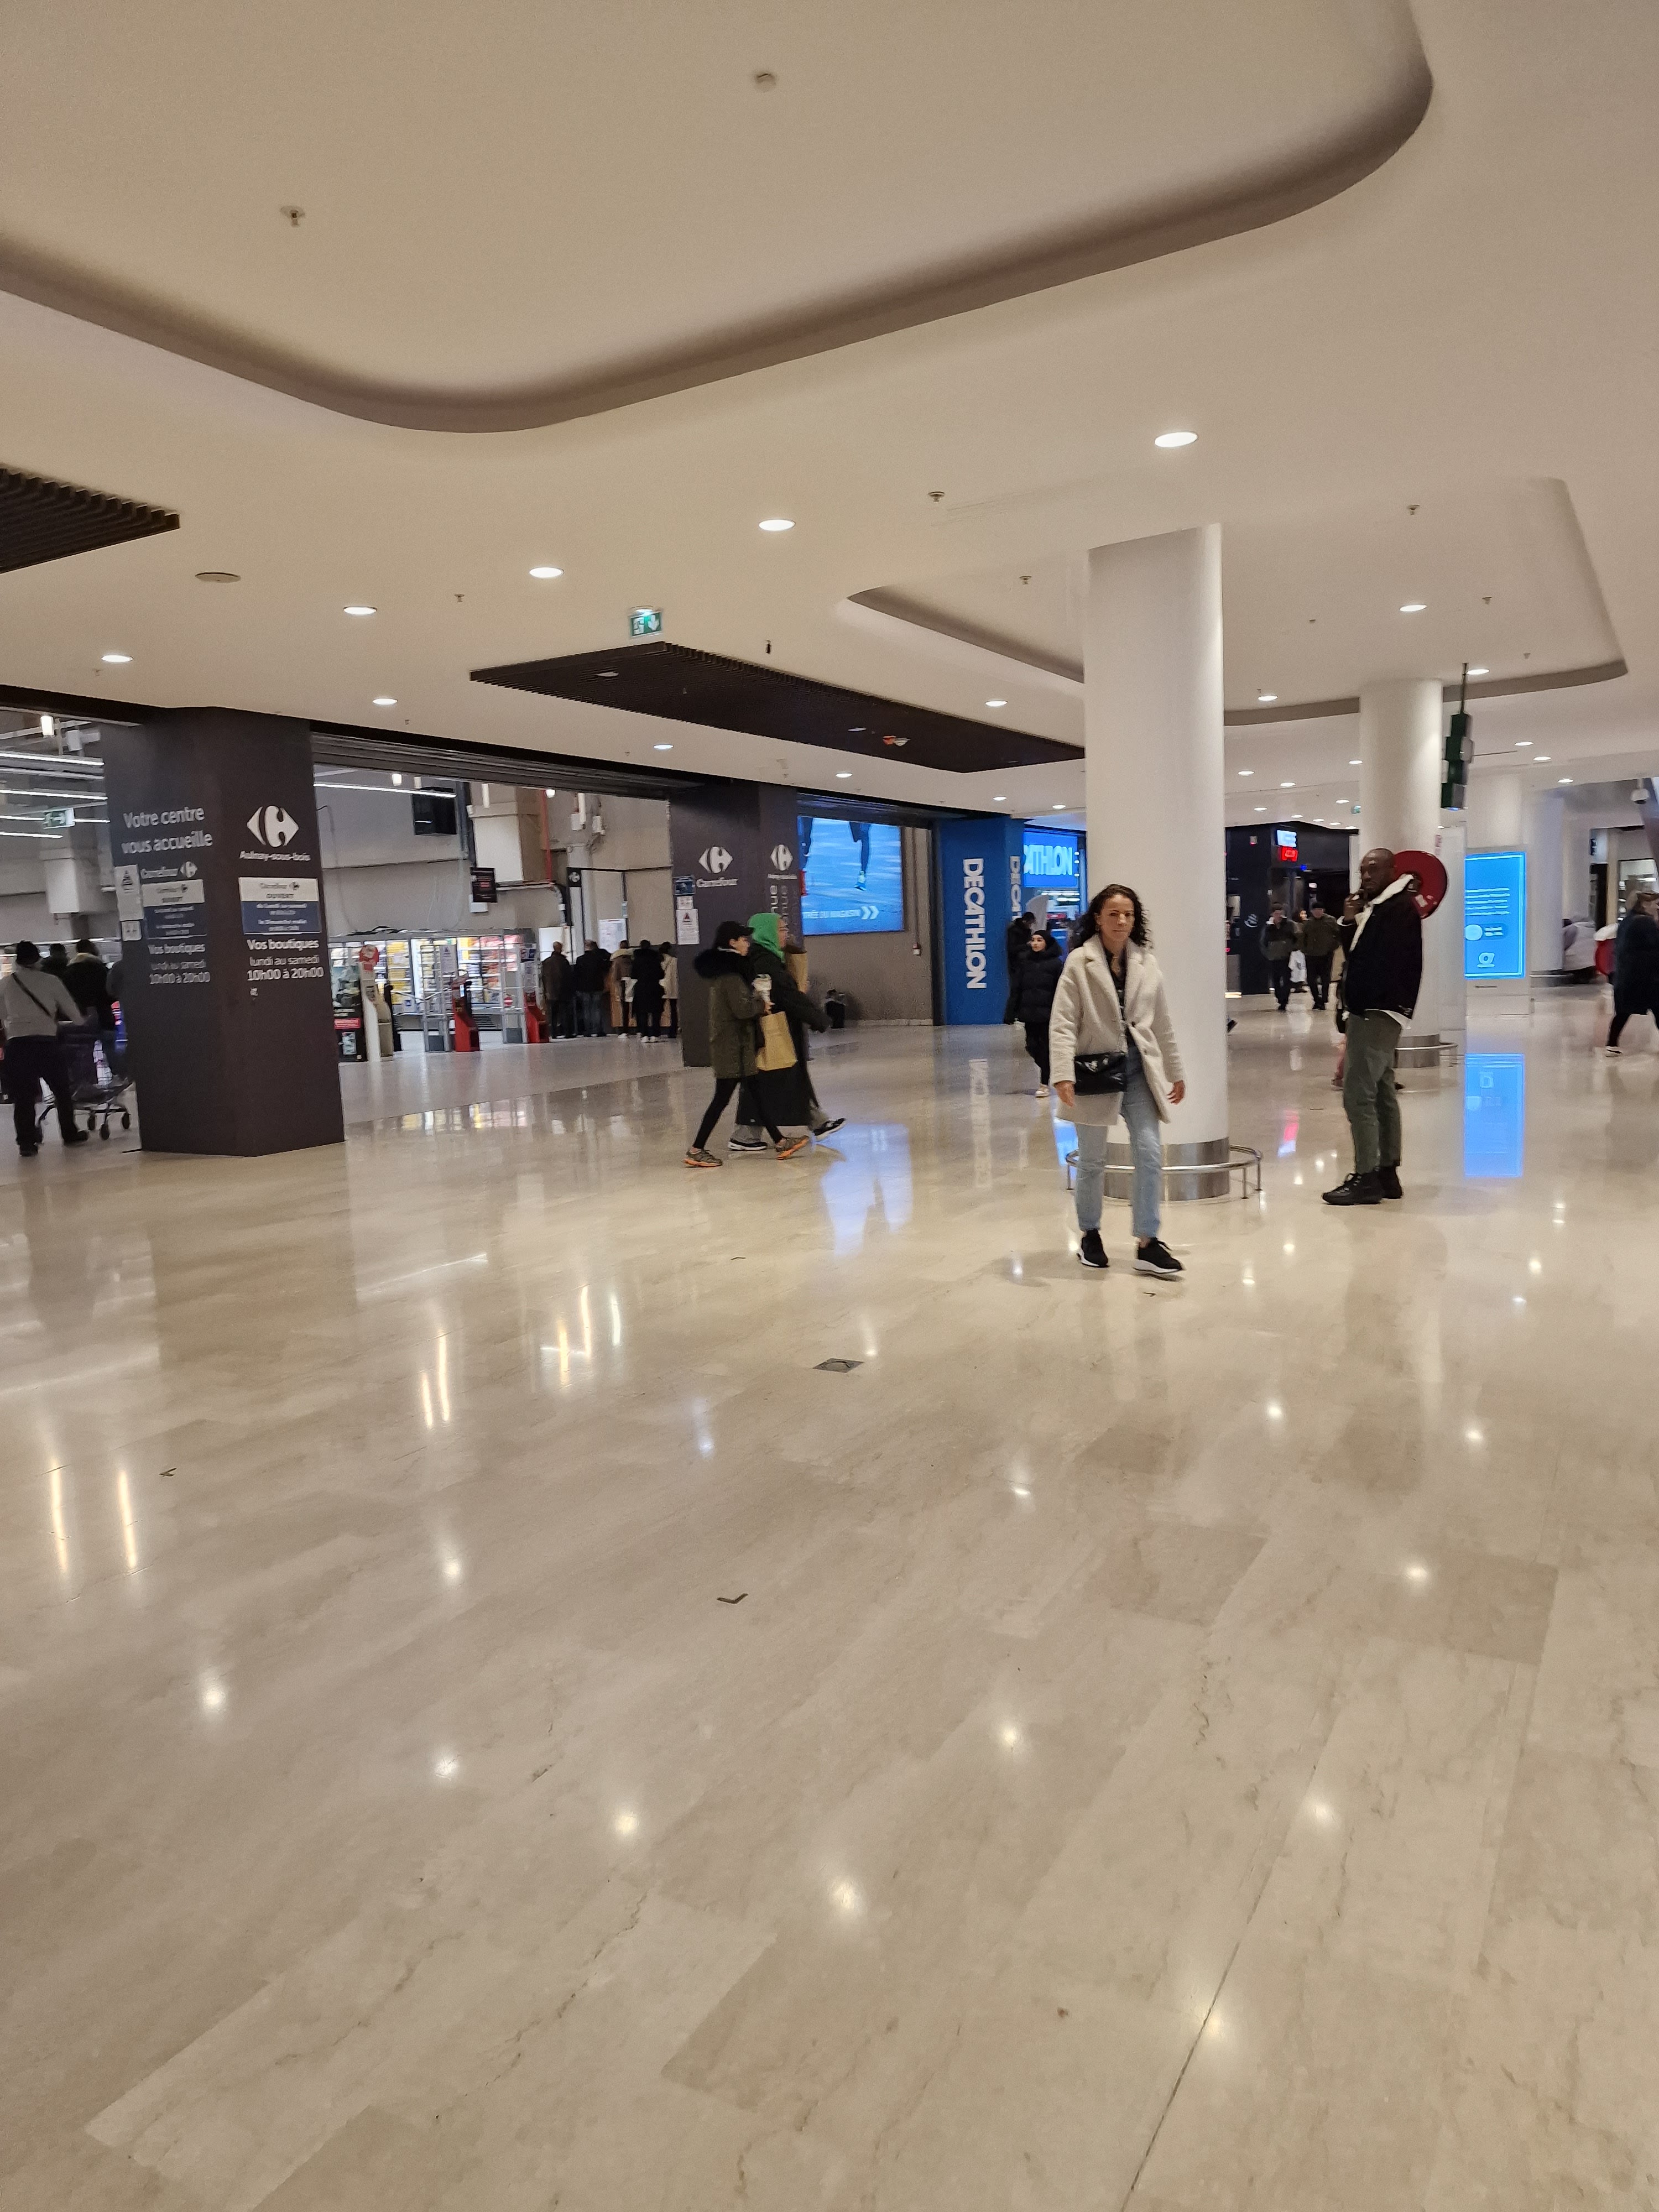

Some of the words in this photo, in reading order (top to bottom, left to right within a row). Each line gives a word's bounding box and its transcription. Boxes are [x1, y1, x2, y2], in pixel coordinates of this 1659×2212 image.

[123, 812, 159, 828] Votre
[160, 806, 205, 825] centre
[121, 840, 152, 854] vous
[153, 830, 213, 851] accueille
[1024, 844, 1073, 875] ATHLON
[696, 877, 738, 888] Carrefour
[963, 858, 987, 989] DECATHLON
[247, 940, 268, 950] Vos
[268, 938, 320, 951] boutiques
[249, 956, 273, 966] lundi
[287, 954, 320, 965] samedi
[247, 969, 281, 981] 10h00
[282, 968, 290, 979] à
[291, 967, 324, 979] 20h00
